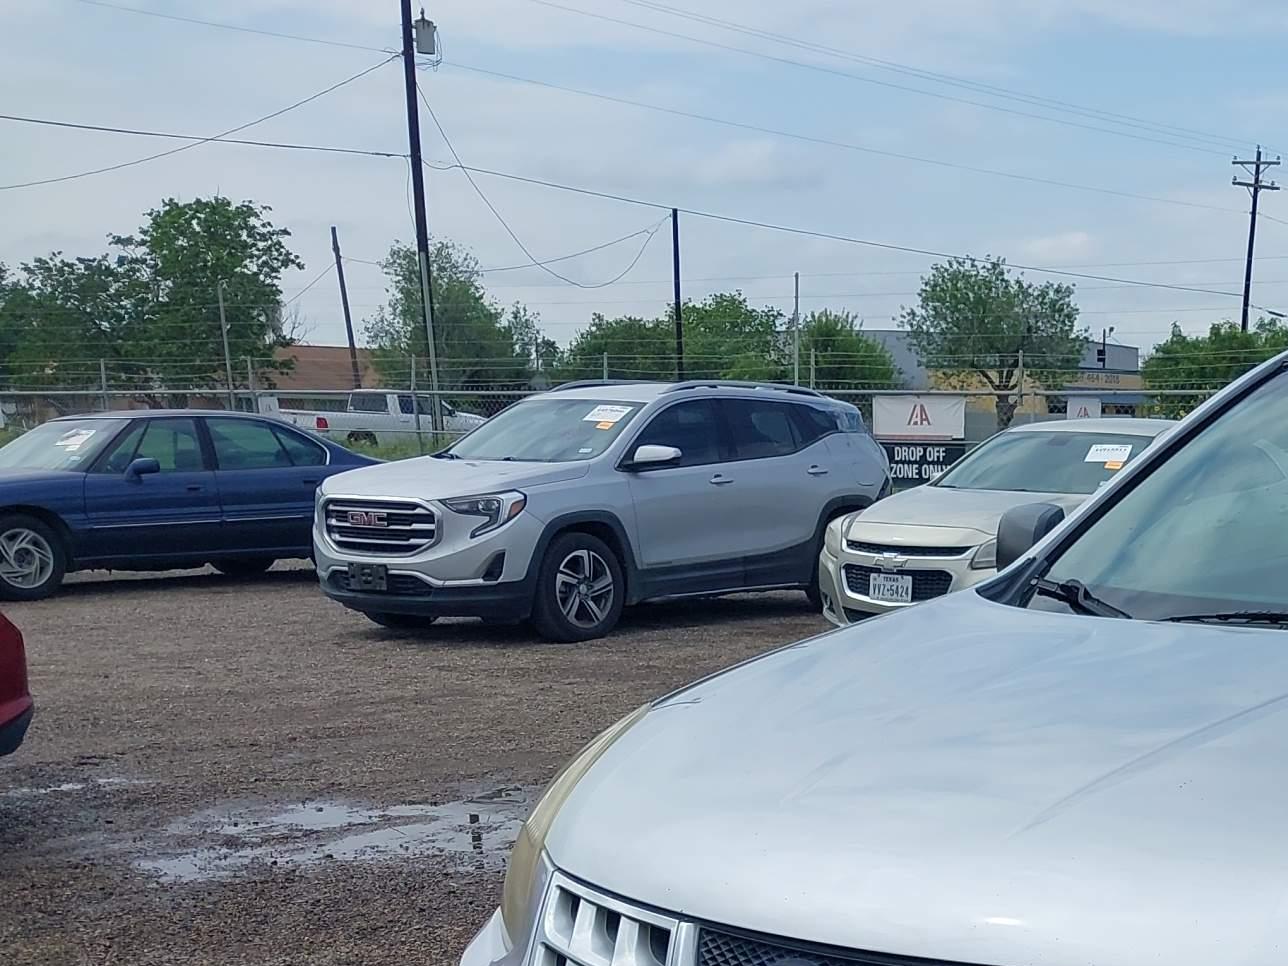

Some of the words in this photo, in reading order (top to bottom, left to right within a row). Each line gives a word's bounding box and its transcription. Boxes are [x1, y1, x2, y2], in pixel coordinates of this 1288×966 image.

[894, 446, 924, 462] DROP
[926, 447, 946, 462] OFF
[890, 463, 920, 479] ZONE
[347, 511, 388, 527] GMC
